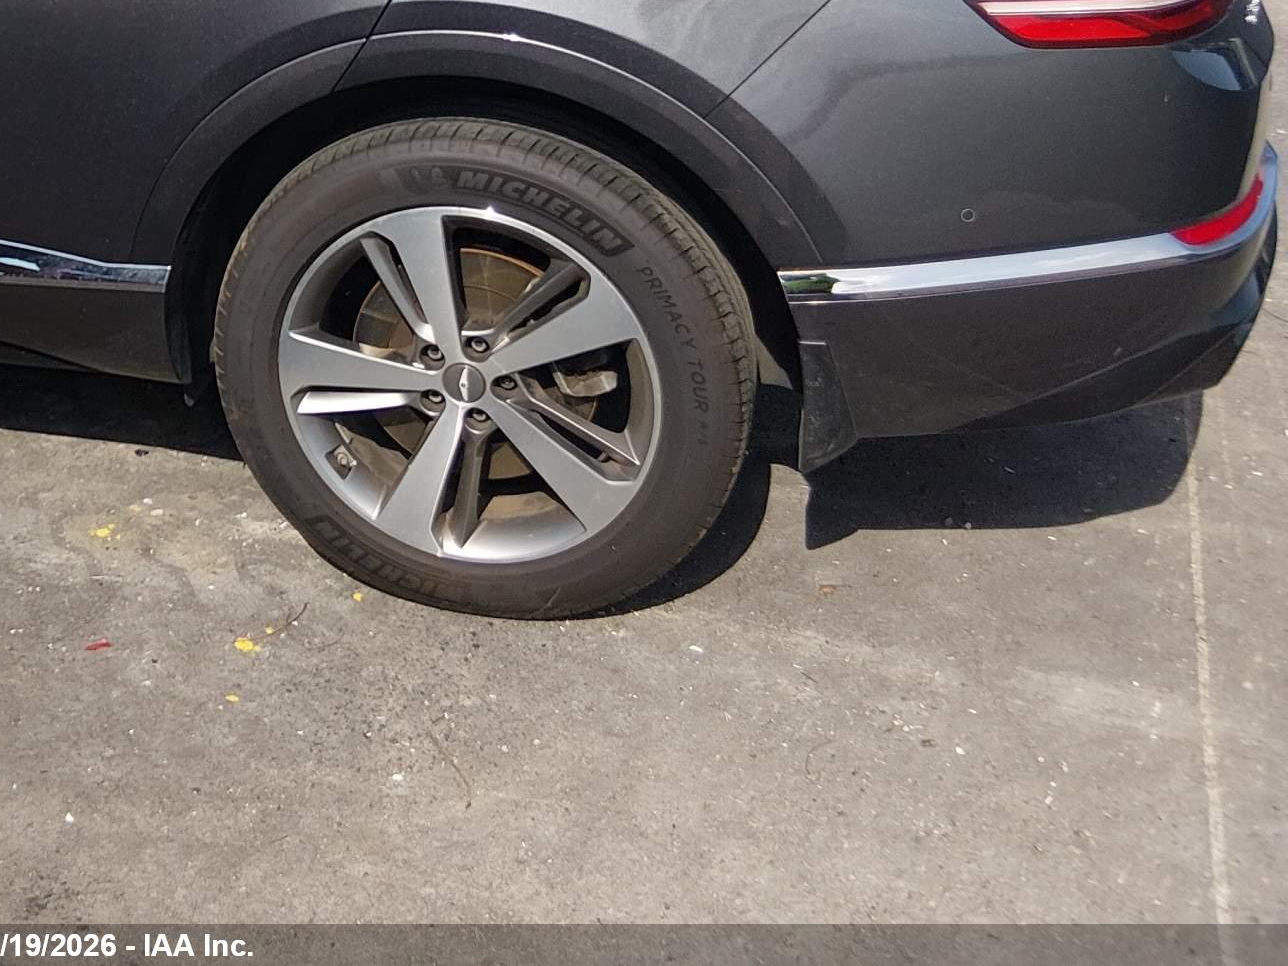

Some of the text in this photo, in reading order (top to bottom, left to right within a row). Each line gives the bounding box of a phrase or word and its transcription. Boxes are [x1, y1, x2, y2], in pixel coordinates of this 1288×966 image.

[456, 170, 622, 254] MICHELIN
[636, 265, 696, 349] PRIMACY
[688, 359, 710, 413] TOUR
